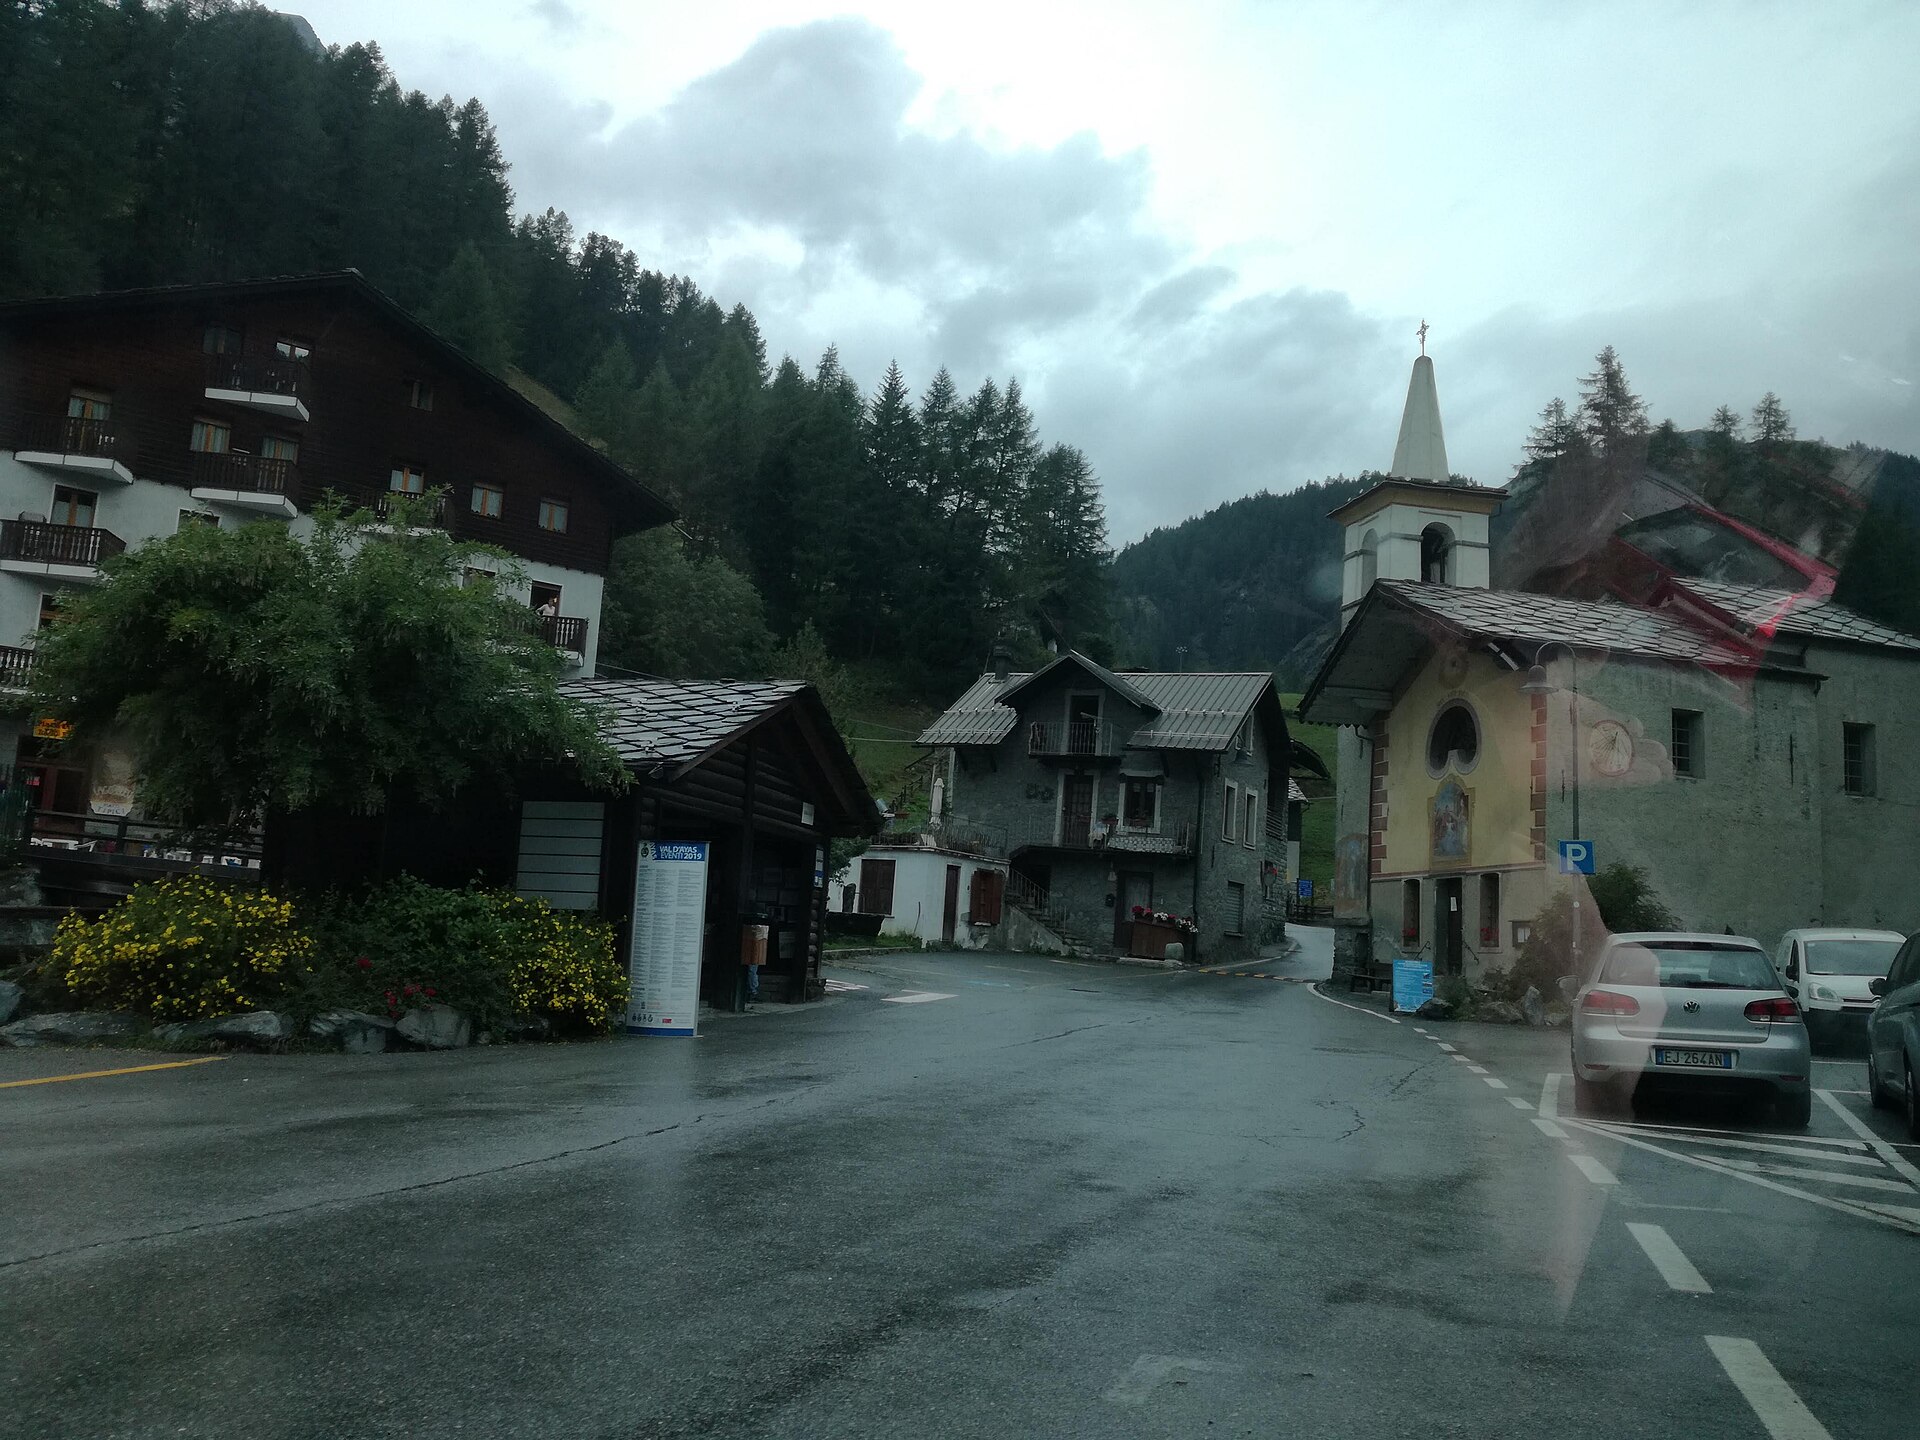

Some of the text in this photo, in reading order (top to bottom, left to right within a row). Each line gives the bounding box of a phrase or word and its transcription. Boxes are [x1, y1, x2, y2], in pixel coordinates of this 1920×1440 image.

[659, 845, 672, 853] VAL
[660, 852, 702, 860] EVENTI 2019
[1566, 843, 1587, 871] P
